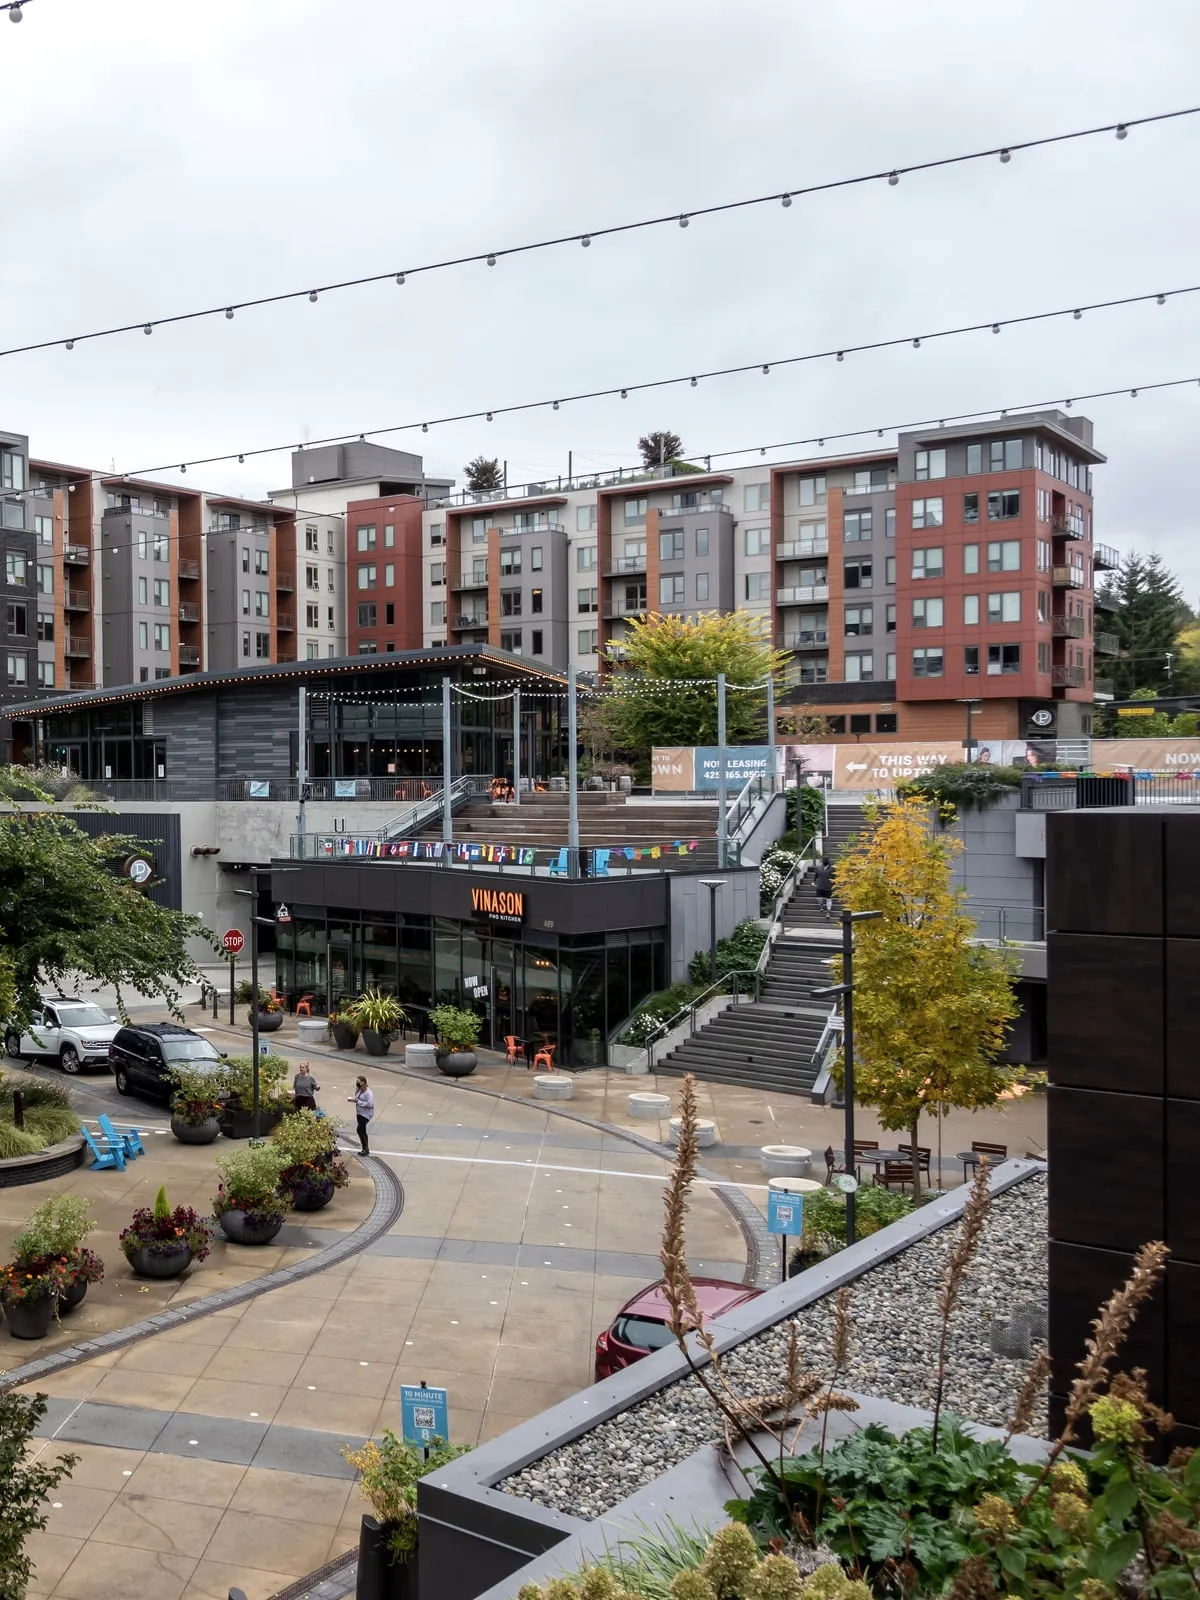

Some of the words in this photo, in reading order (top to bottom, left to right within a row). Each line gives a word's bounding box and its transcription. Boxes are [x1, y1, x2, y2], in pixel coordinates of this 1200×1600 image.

[703, 760, 720, 768] NO
[727, 759, 767, 768] LEASING
[879, 755, 912, 766] THIS
[916, 755, 948, 765] WAY
[872, 768, 889, 778] TO
[893, 768, 935, 778] UPTO
[471, 888, 523, 916] VINASON
[500, 914, 522, 922] KITCHEN
[223, 936, 244, 947] STOP
[464, 976, 478, 988] NOW
[473, 985, 489, 998] OPEN
[414, 1391, 443, 1400] MINUTE
[421, 1429, 429, 1440] 8
